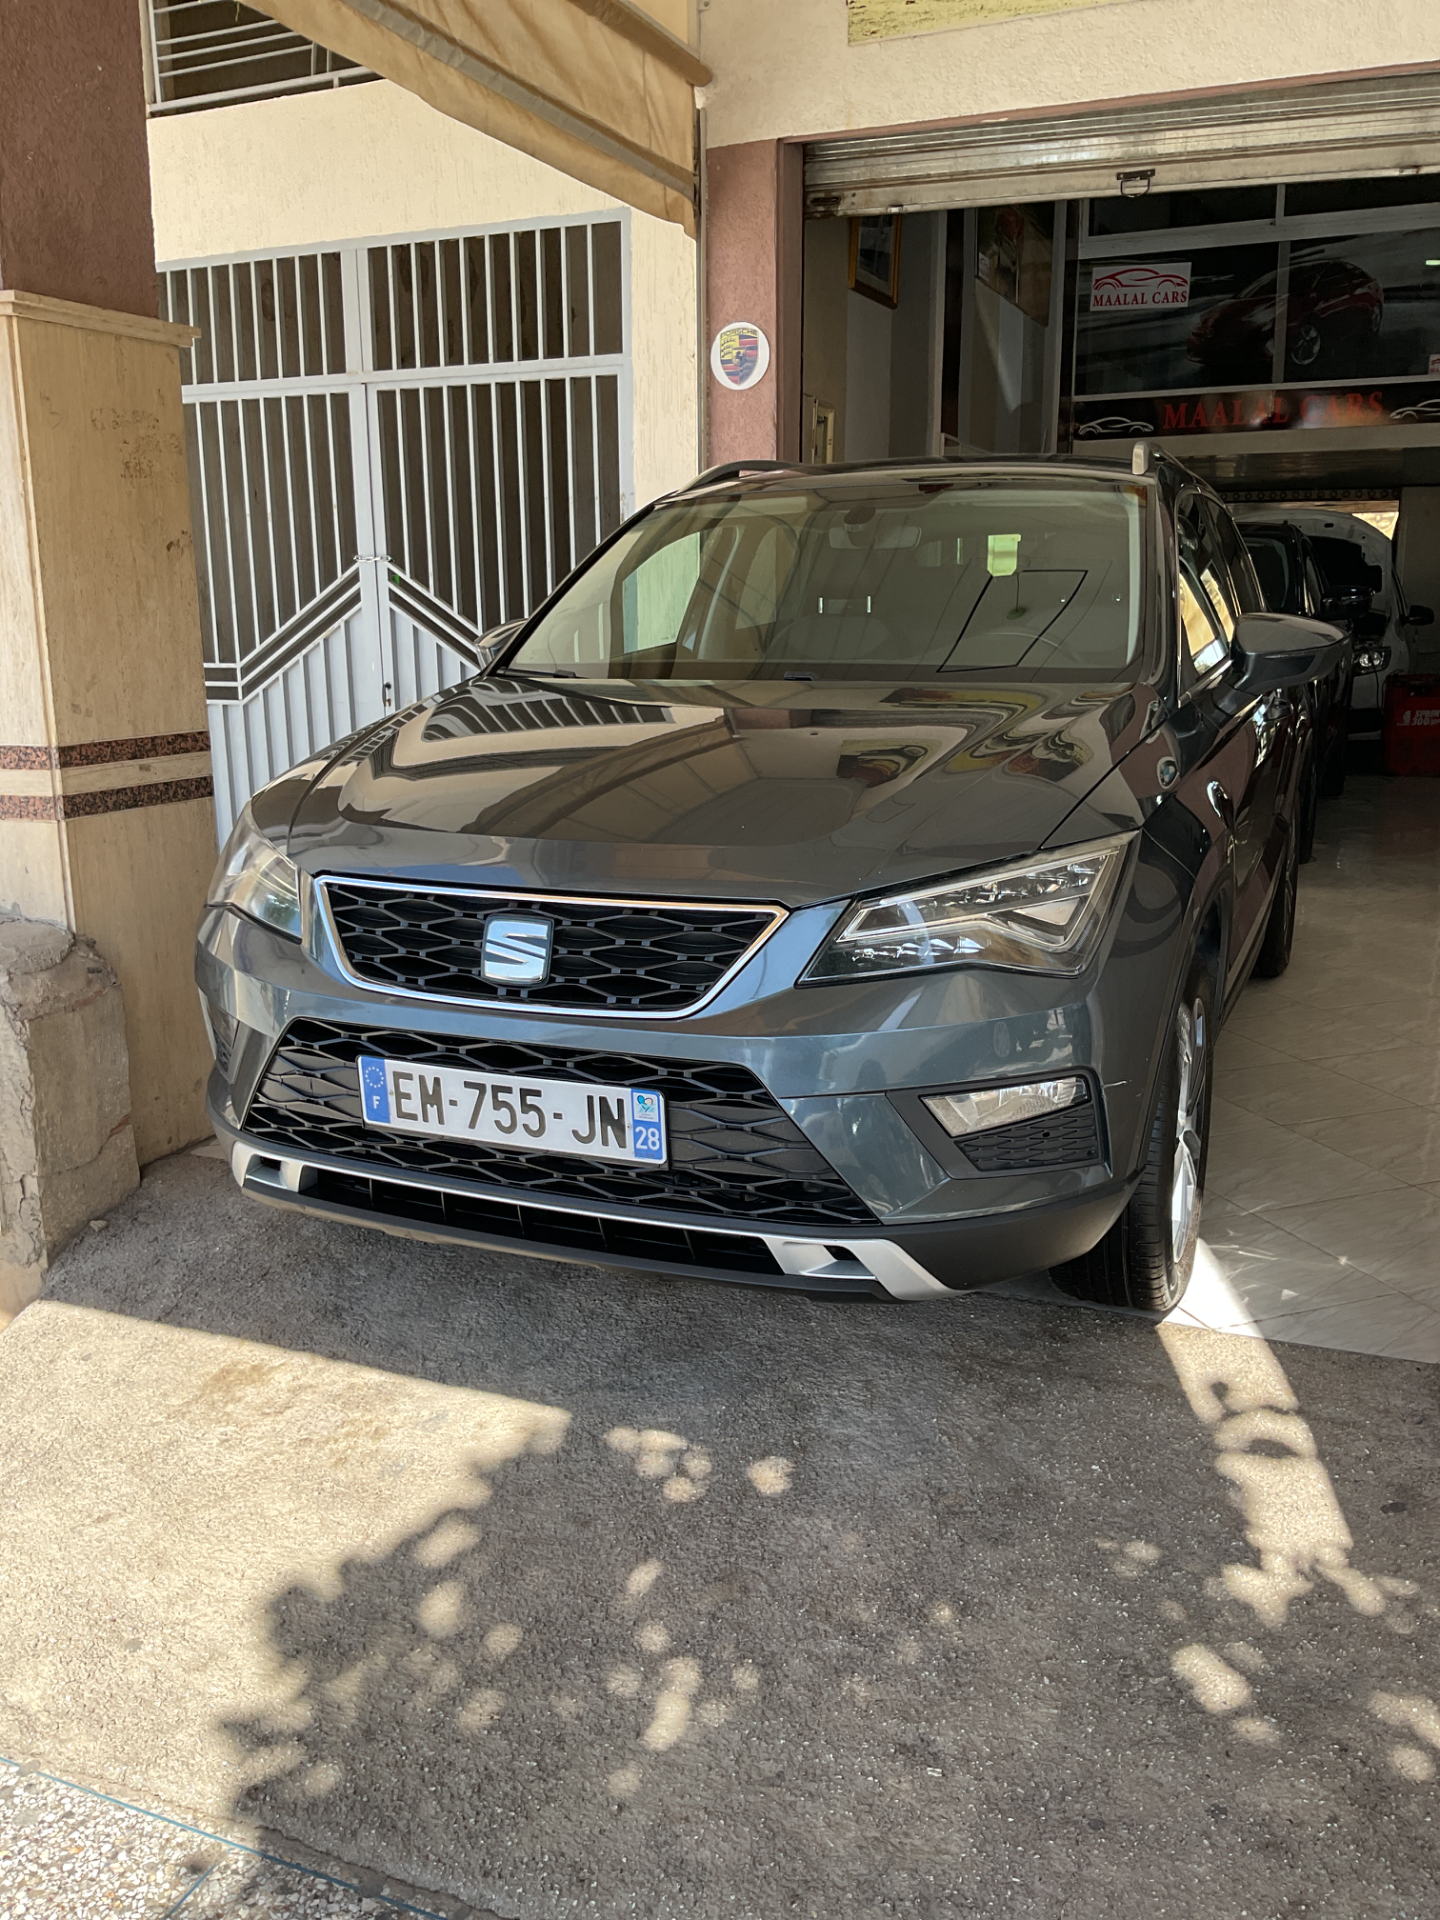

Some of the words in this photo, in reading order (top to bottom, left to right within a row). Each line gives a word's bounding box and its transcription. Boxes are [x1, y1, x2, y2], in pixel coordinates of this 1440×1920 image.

[1093, 292, 1147, 307] MAALAL
[1152, 290, 1187, 304] CARS
[720, 328, 758, 339] PORSCHE
[1162, 396, 1289, 430] MAALAL
[1300, 391, 1384, 423] CARS
[372, 1095, 381, 1110] F
[391, 1070, 629, 1149] EM-755-JN
[635, 1126, 660, 1151] 28
